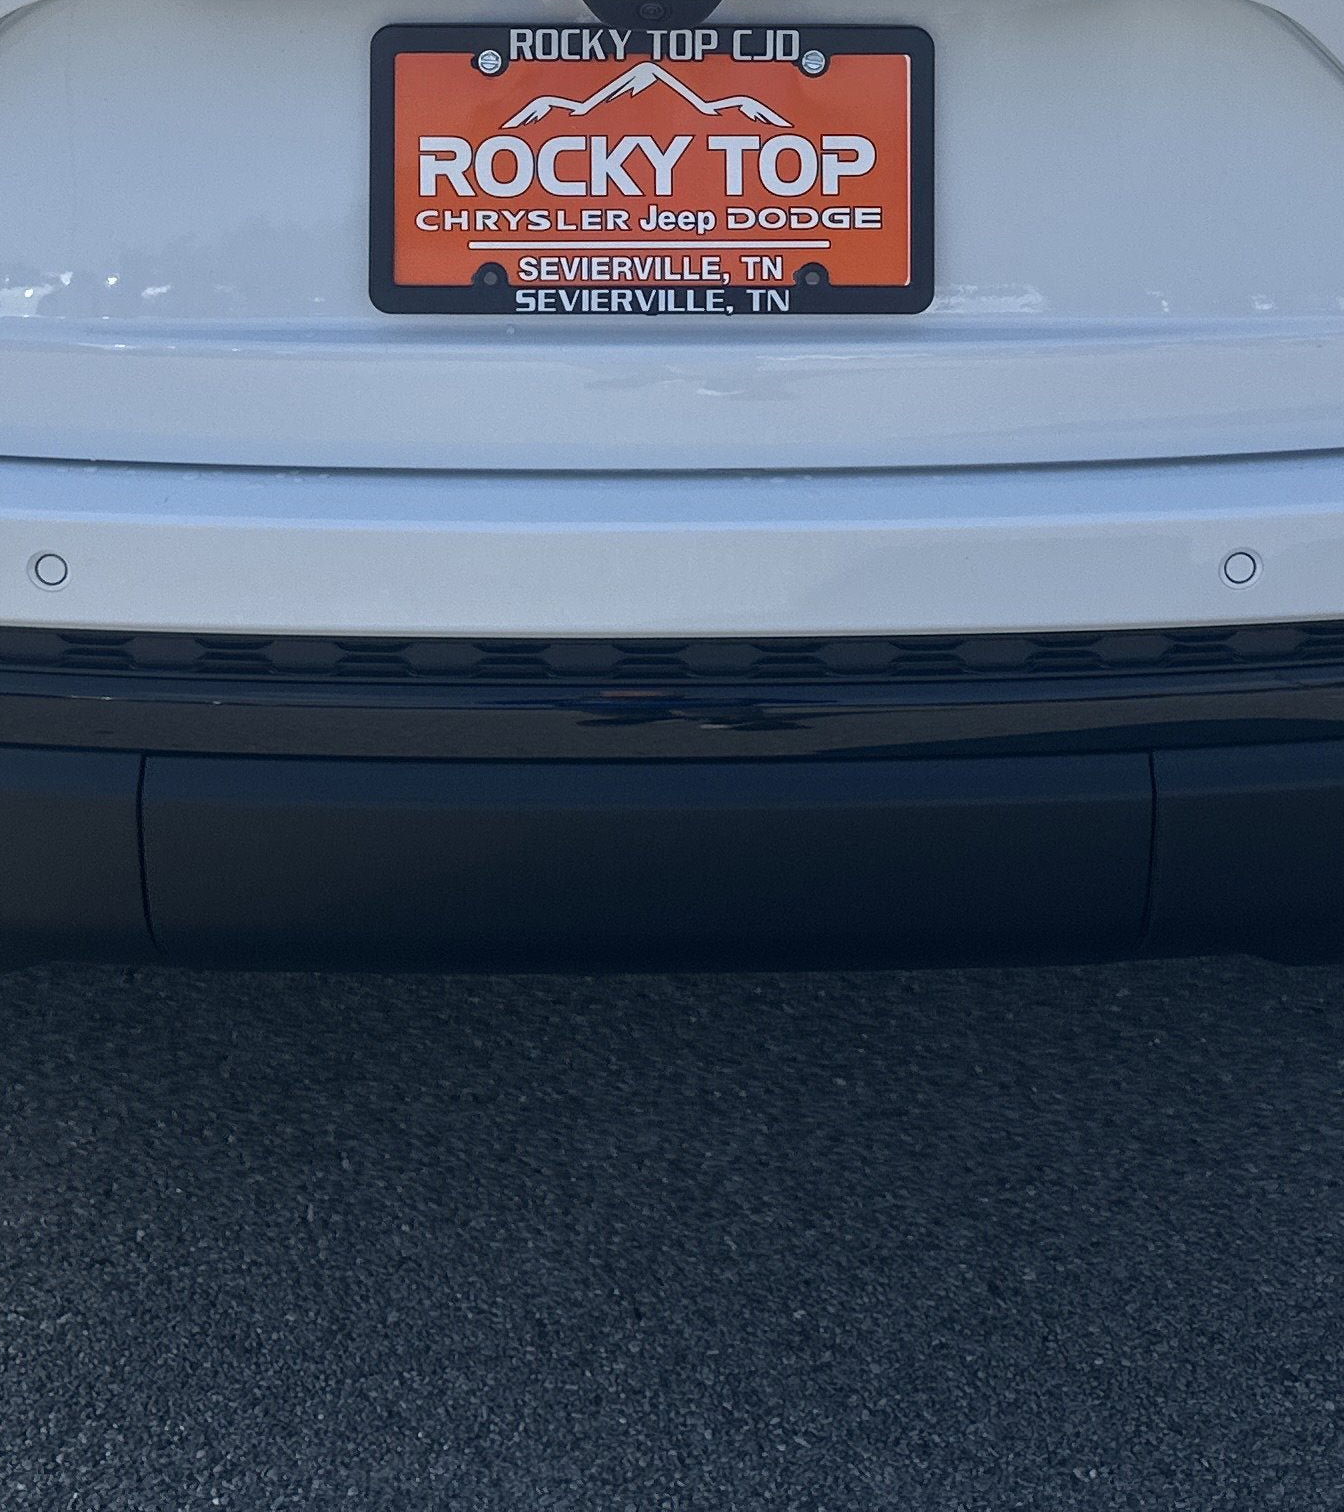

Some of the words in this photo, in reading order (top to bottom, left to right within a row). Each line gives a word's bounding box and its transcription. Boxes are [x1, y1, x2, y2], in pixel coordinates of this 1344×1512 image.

[509, 28, 633, 61] ROCKY
[646, 29, 719, 61] TOP
[732, 29, 800, 61] CJD
[418, 134, 695, 198] ROCKY
[708, 134, 876, 197] TOP
[415, 208, 629, 232] CHRYSLER
[639, 203, 716, 235] Jeep
[727, 206, 883, 230] DODGE
[517, 256, 731, 285] SEVIERVILLE,
[742, 256, 784, 281] TN
[515, 288, 734, 315] SEVIERVILLE,
[746, 288, 791, 313] TN
